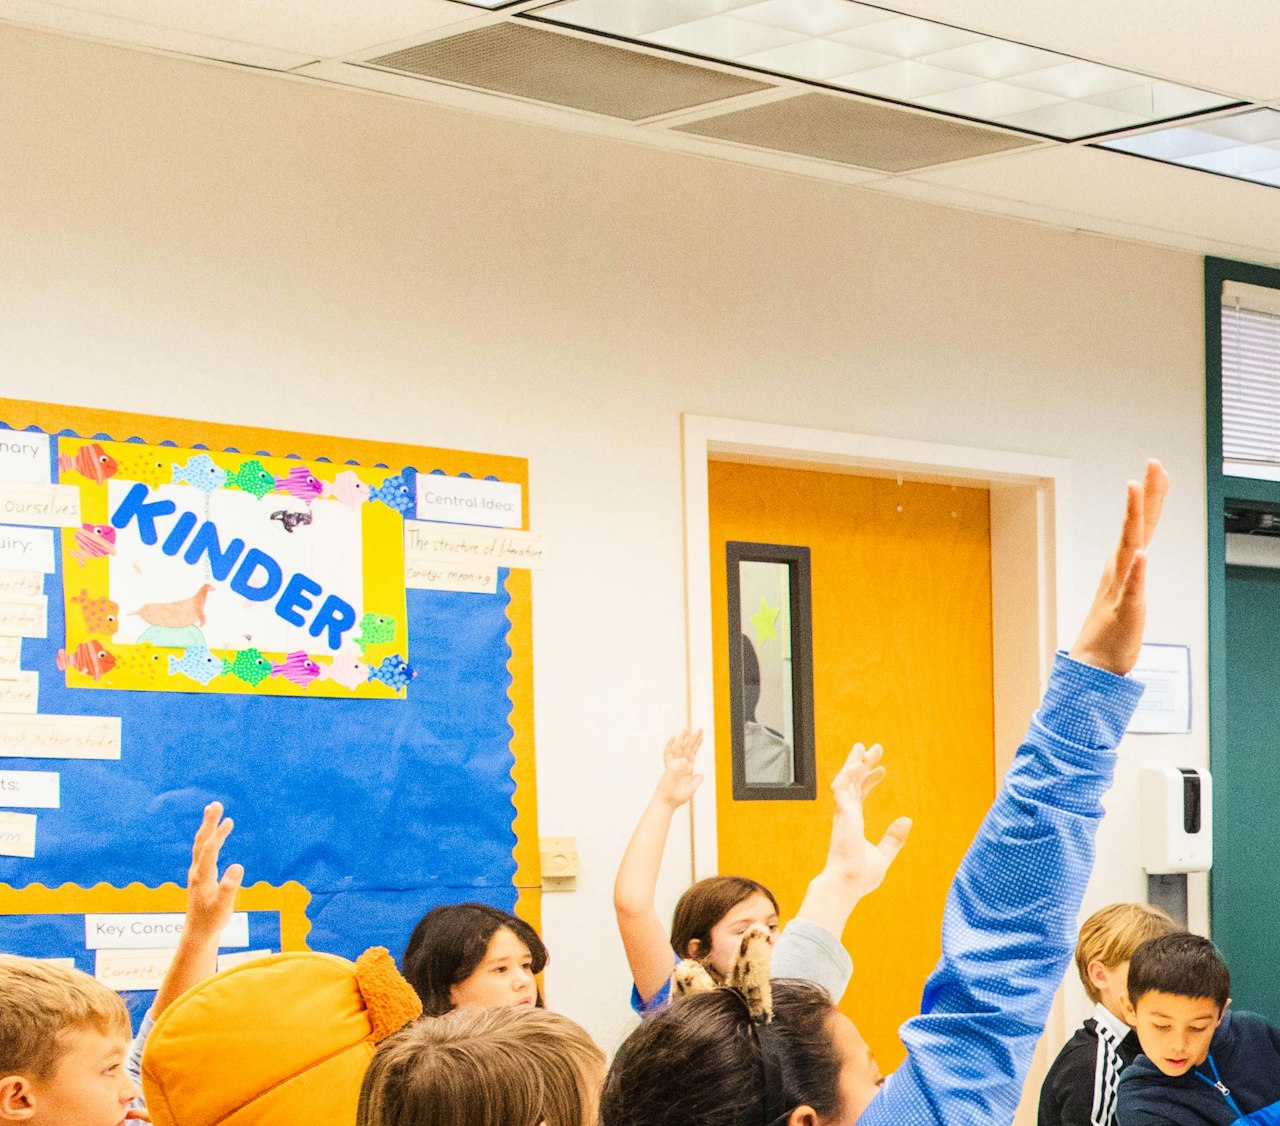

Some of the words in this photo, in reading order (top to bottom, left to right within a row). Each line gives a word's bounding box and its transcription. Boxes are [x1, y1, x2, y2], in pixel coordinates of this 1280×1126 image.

[424, 491, 478, 509] Central
[481, 497, 515, 513] Idea:
[407, 528, 430, 551] The
[111, 483, 356, 650] KINDER
[96, 922, 126, 938] Key
[130, 921, 184, 935] Conce
